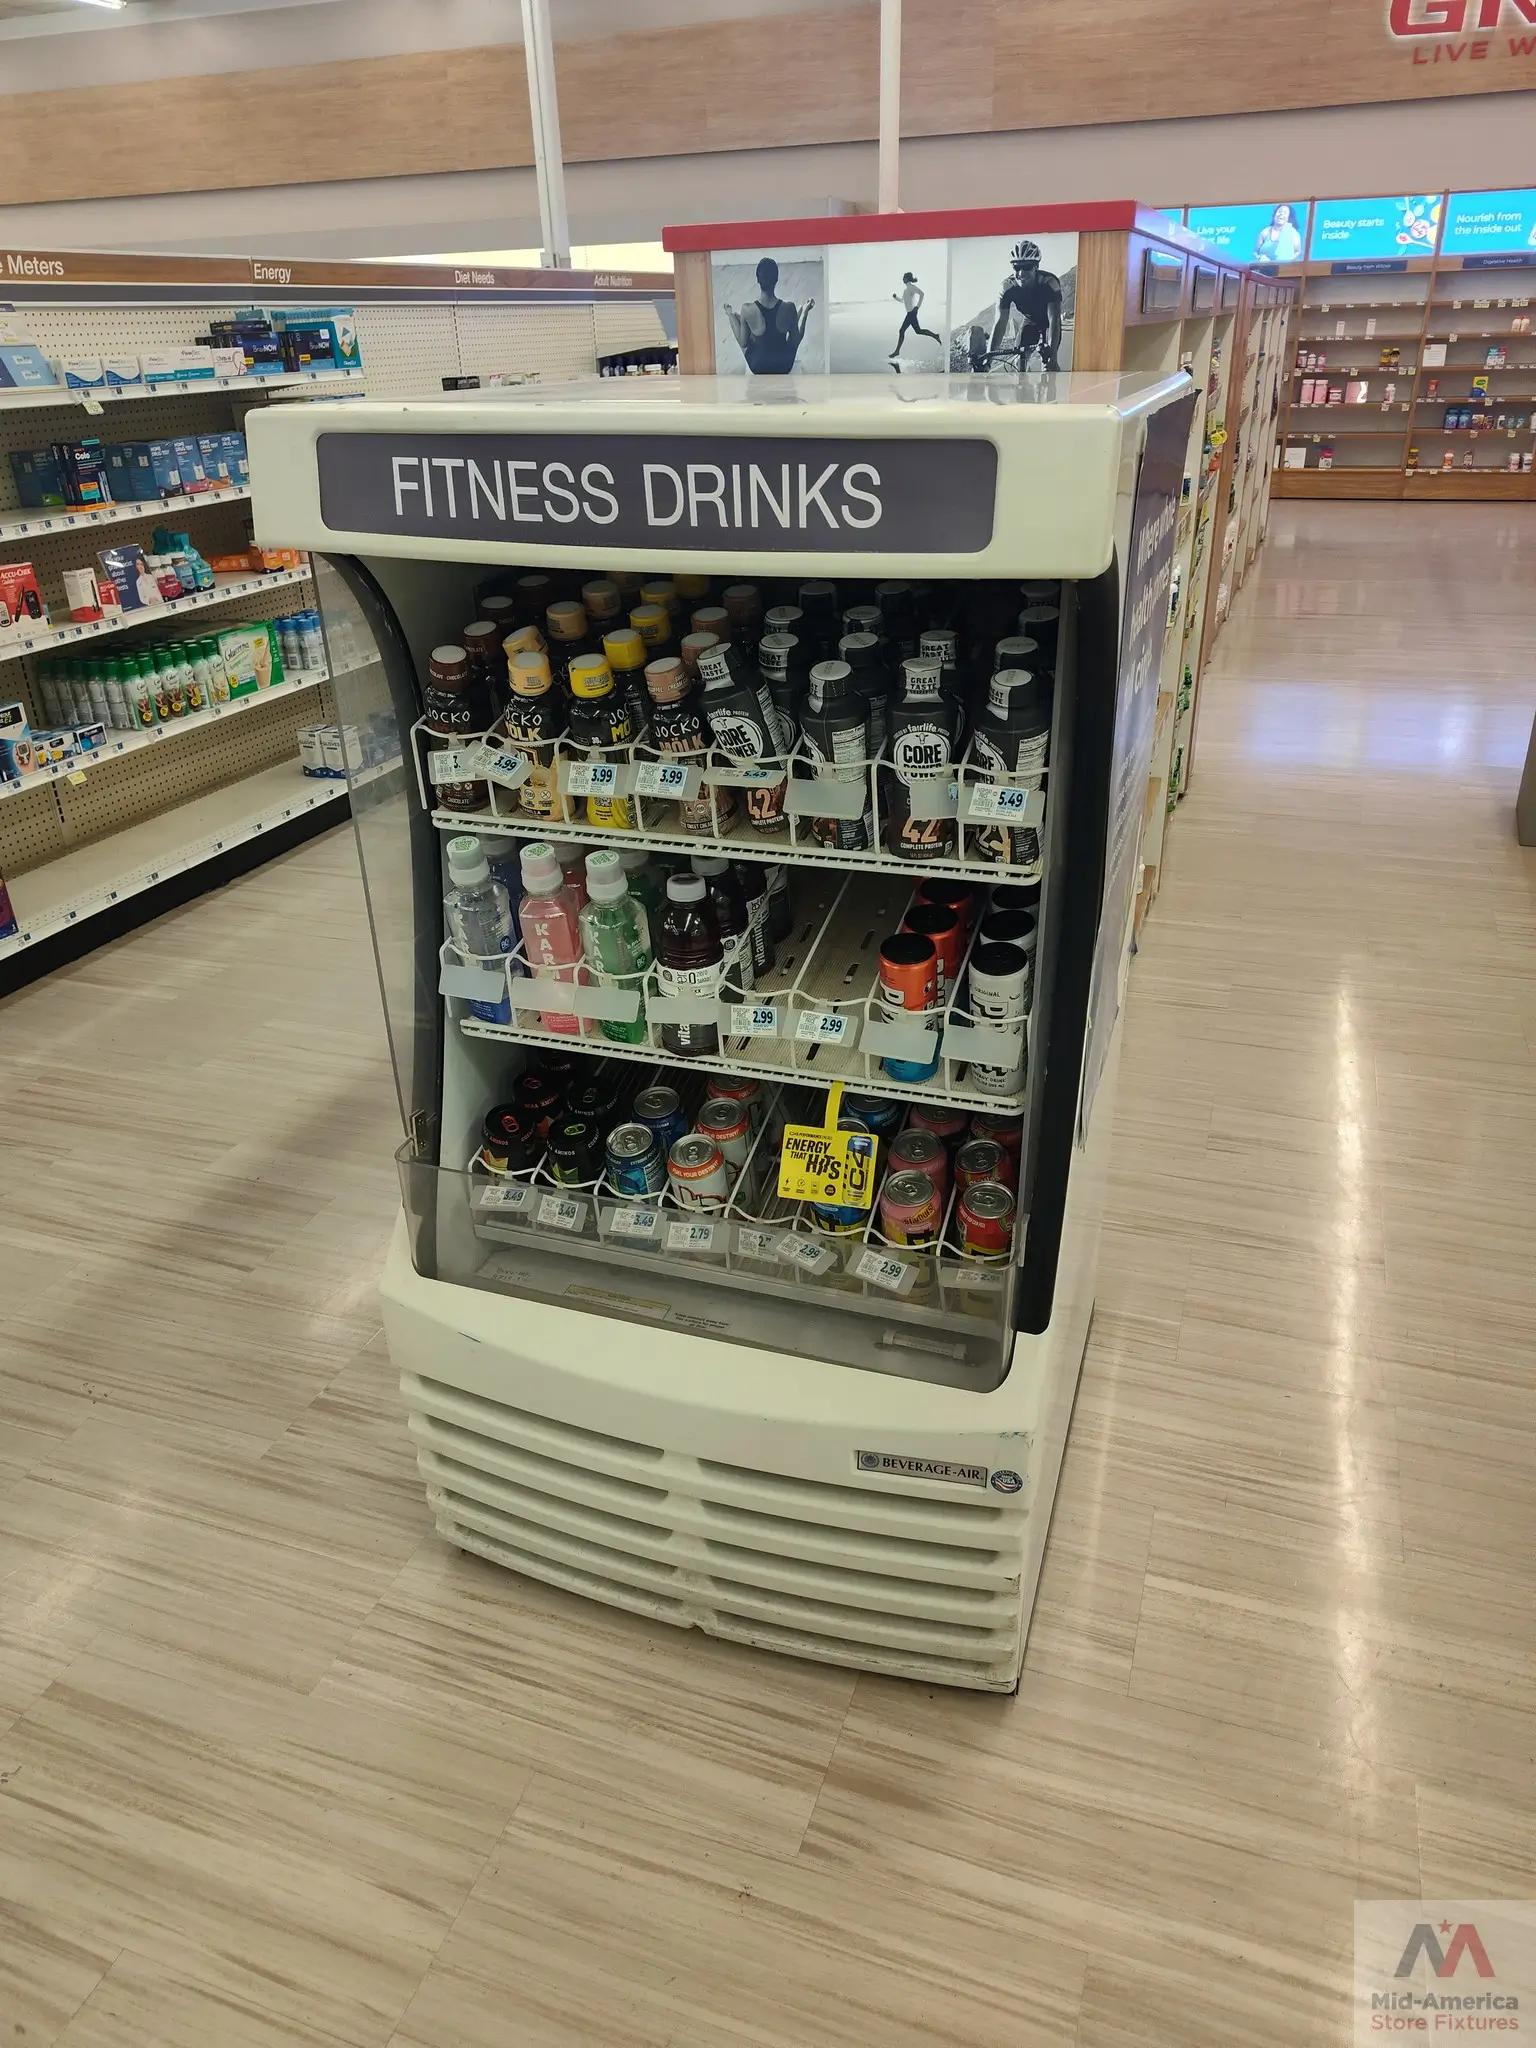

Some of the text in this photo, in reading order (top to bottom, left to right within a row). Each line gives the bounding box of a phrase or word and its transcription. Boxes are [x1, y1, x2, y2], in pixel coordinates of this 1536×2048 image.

[1412, 40, 1490, 65] LIVE
[1323, 217, 1385, 230] Beauty starts
[1456, 212, 1522, 224] Nourish from
[1215, 226, 1237, 236] your
[1321, 230, 1350, 241] inside
[1454, 223, 1522, 235] the inside out
[7, 254, 65, 276] Meters
[253, 263, 292, 283] Energy
[454, 270, 496, 285] Diet Needs
[594, 275, 633, 287] Adult Nutrition
[390, 456, 882, 529] FITNESS DRINKS
[921, 643, 950, 652] GREAT
[700, 661, 722, 671] GREAT
[702, 668, 725, 678] TASTE
[910, 676, 937, 684] GREAT
[910, 683, 937, 691] TASTE
[427, 707, 471, 724] JOCKO
[505, 708, 543, 728] OCKO
[655, 716, 700, 739] JOCKO
[907, 722, 938, 733] fairlife
[715, 724, 752, 747] CORE
[903, 744, 943, 764] CORE
[493, 756, 518, 771] 3.99
[590, 768, 613, 783] 3.99
[659, 769, 683, 784] 3.99
[742, 770, 768, 779] 5.49
[997, 791, 1024, 807] 5.49
[901, 815, 942, 844] 42
[900, 842, 943, 850] COMPLETE PROTEIN
[973, 985, 1001, 998] ORIGINAL
[752, 1010, 774, 1024] 2.99
[820, 1017, 843, 1033] 2.99
[554, 1147, 575, 1155] AMINOS
[785, 1137, 832, 1155] ENERGY
[790, 1150, 842, 1180] THAT HITS
[504, 1190, 524, 1202] 3.49
[557, 1202, 576, 1218] 3.49
[633, 1213, 655, 1227] 3.49
[689, 1226, 710, 1240] 2.79
[799, 1244, 821, 1259] 2.99
[879, 1260, 902, 1278] 2.99
[882, 1456, 980, 1481] BEVERAGE-AIR
